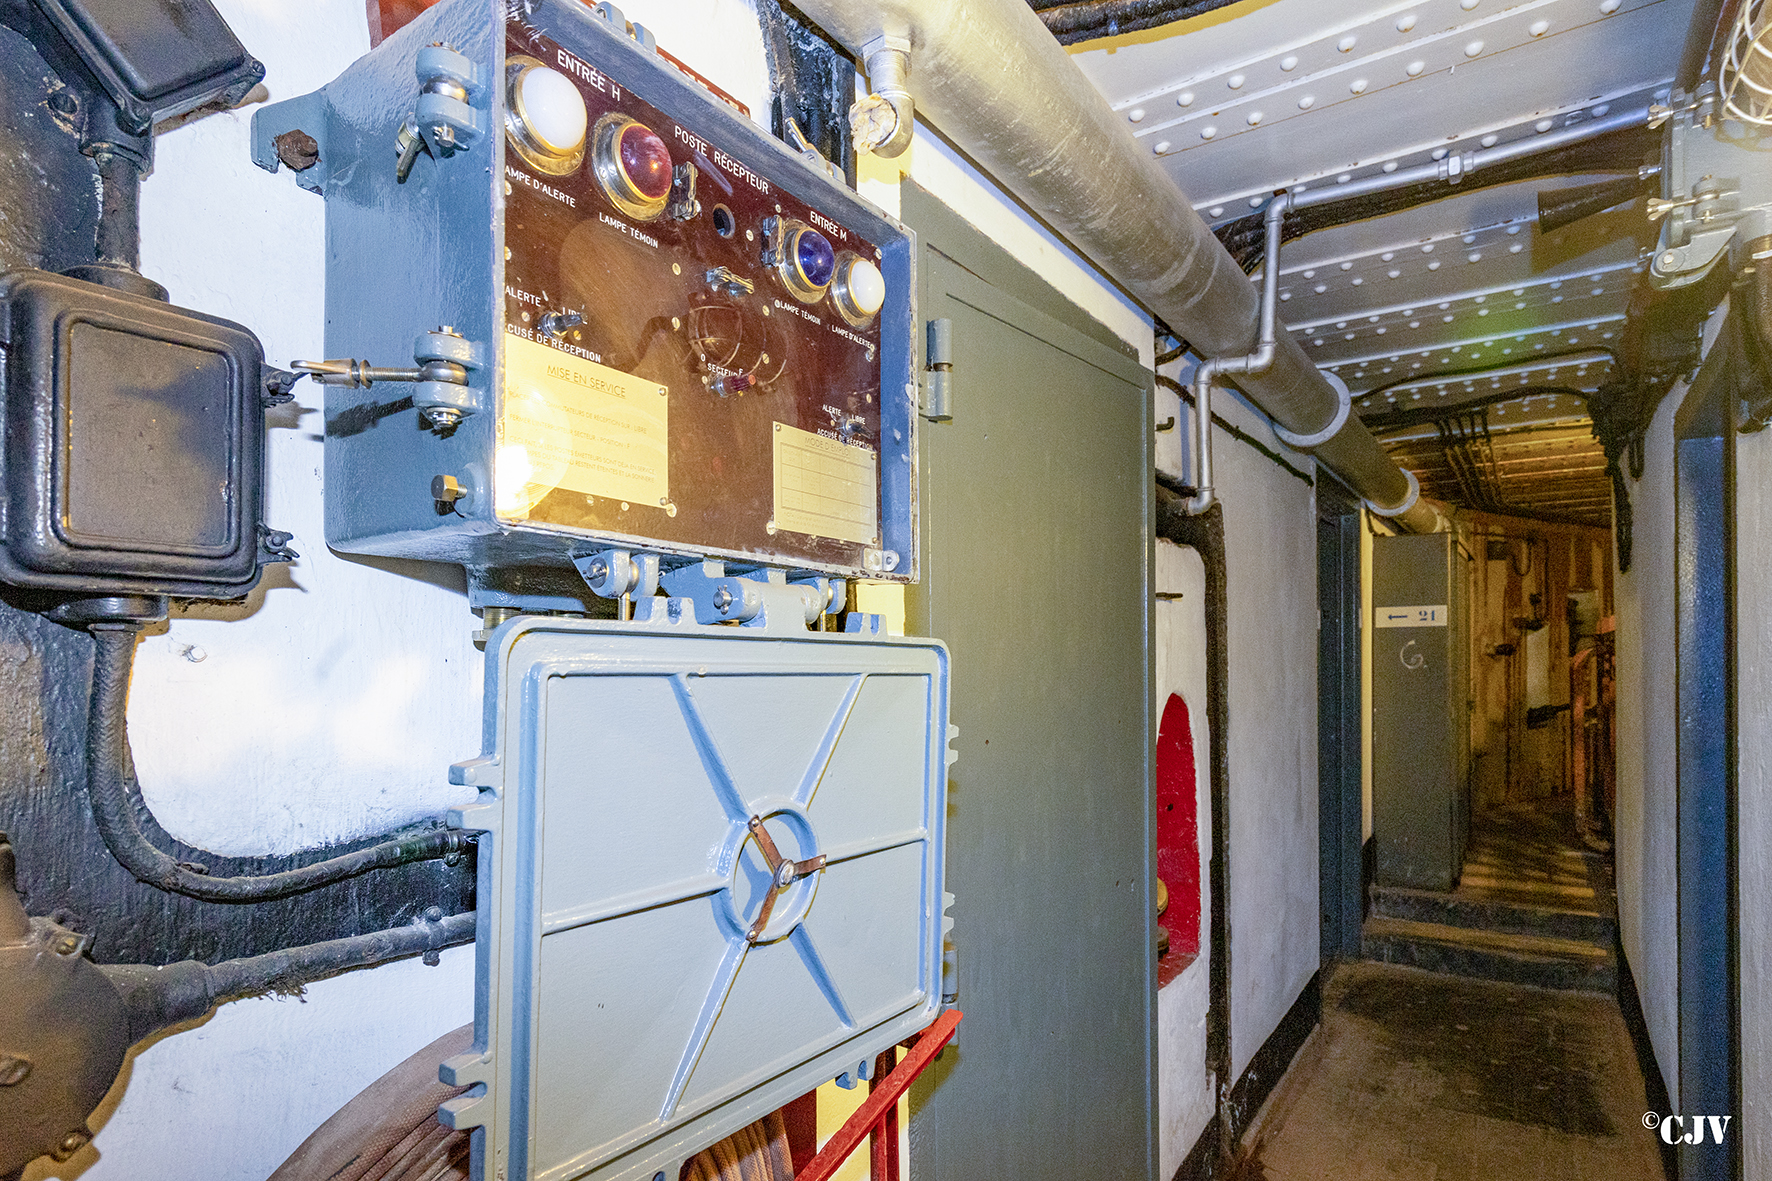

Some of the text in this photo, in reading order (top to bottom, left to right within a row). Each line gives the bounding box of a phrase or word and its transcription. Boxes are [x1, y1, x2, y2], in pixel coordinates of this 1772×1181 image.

[557, 49, 620, 101] ENTRÉE H
[674, 125, 769, 194] POSTE RÉCEPTEUR
[505, 165, 576, 208] AMPE D'ALERTE
[599, 212, 658, 248] LAMPE TÉMOIN
[810, 210, 846, 242] ENTRÉE M
[505, 285, 541, 307] ALERTE
[780, 300, 820, 325] LAMPE TÉMOIN
[507, 324, 601, 364] CUSÉ DE RÉCEPTION
[831, 324, 848, 338] LAMPE
[546, 365, 626, 397] MISE EN SERVICE
[822, 404, 841, 416] ALERTE
